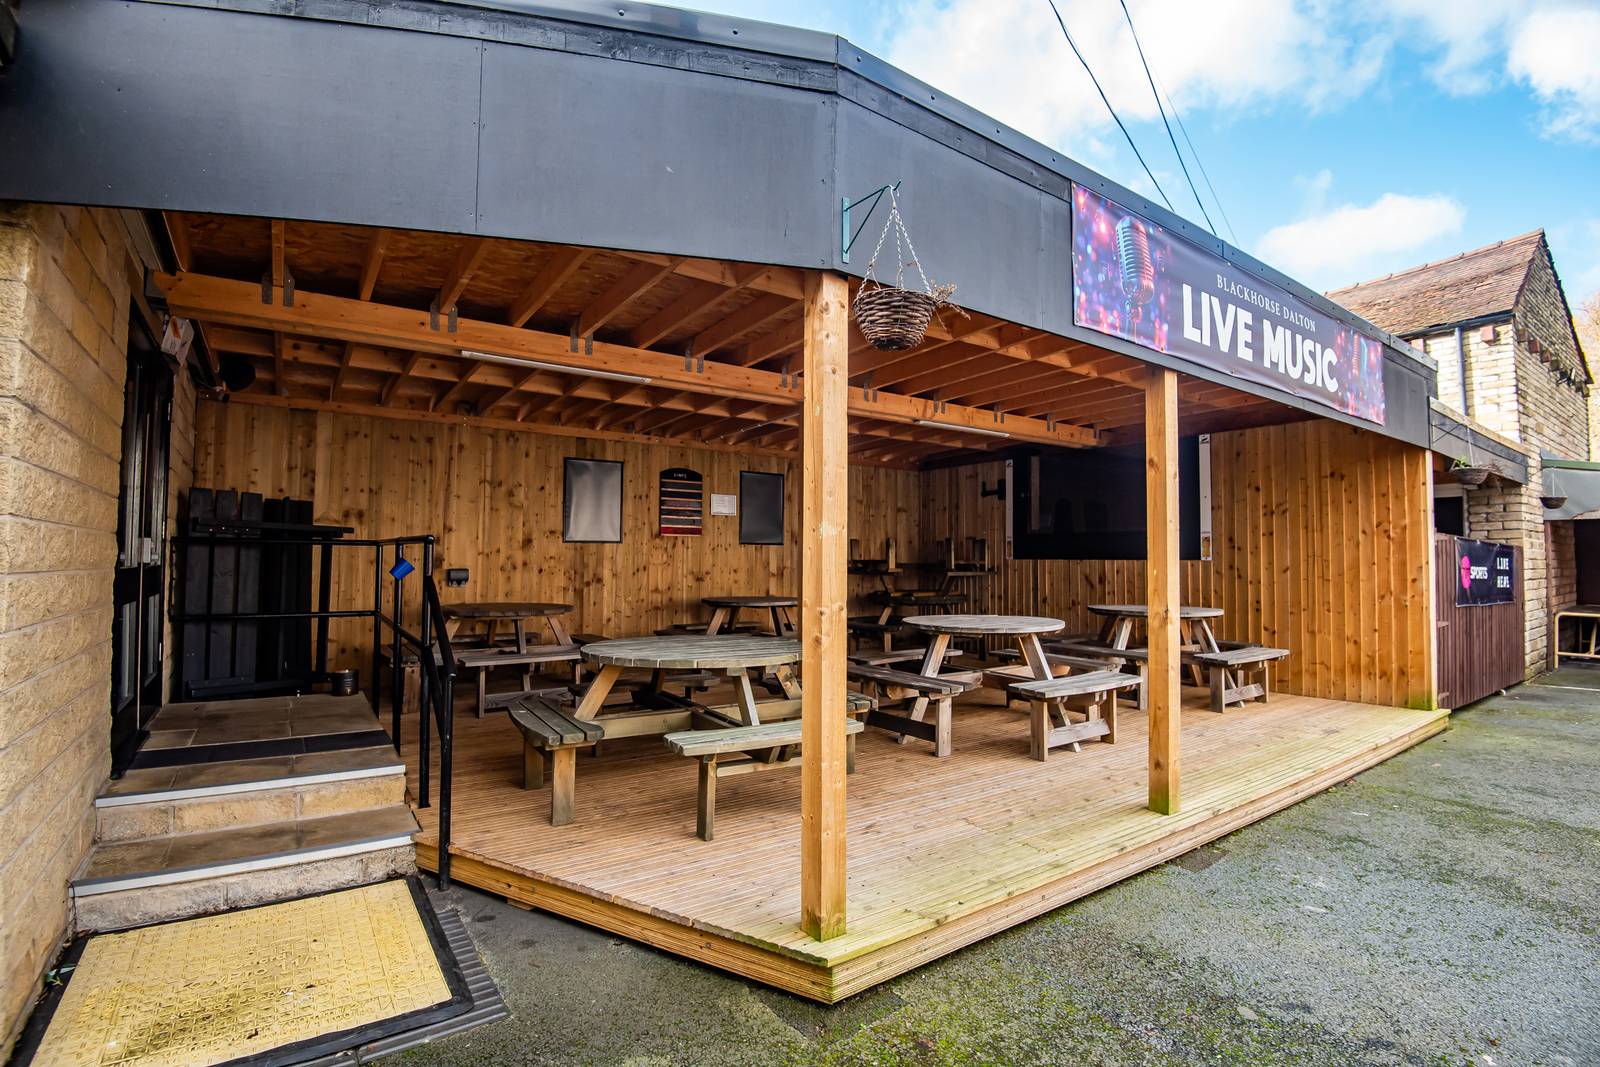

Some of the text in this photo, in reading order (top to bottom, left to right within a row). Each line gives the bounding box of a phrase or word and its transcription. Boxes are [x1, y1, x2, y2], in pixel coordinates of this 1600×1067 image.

[1216, 274, 1316, 332] BLACKHORSE DALTON
[1182, 283, 1339, 393] LIVE MUSIC
[1470, 566, 1488, 580] SPORTS
